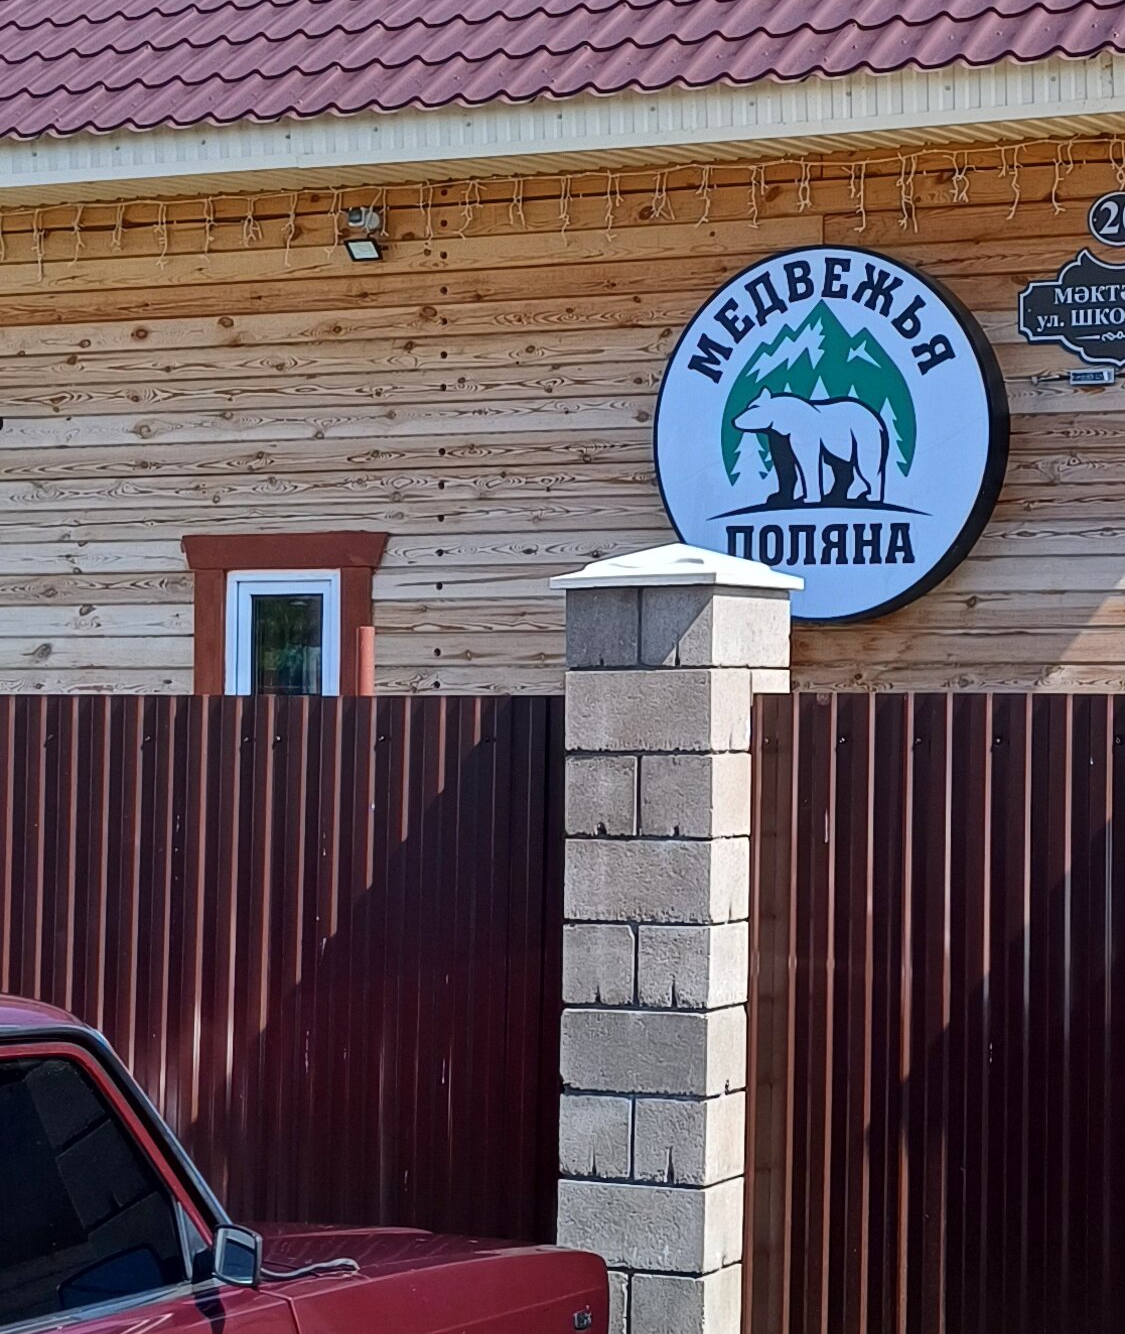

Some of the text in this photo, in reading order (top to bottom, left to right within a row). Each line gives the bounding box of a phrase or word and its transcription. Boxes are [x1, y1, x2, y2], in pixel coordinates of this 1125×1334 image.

[687, 256, 957, 385] МЕДВЕЖЬЯ
[1036, 315, 1065, 332] ул.
[725, 522, 916, 567] ПОЛЯНА
